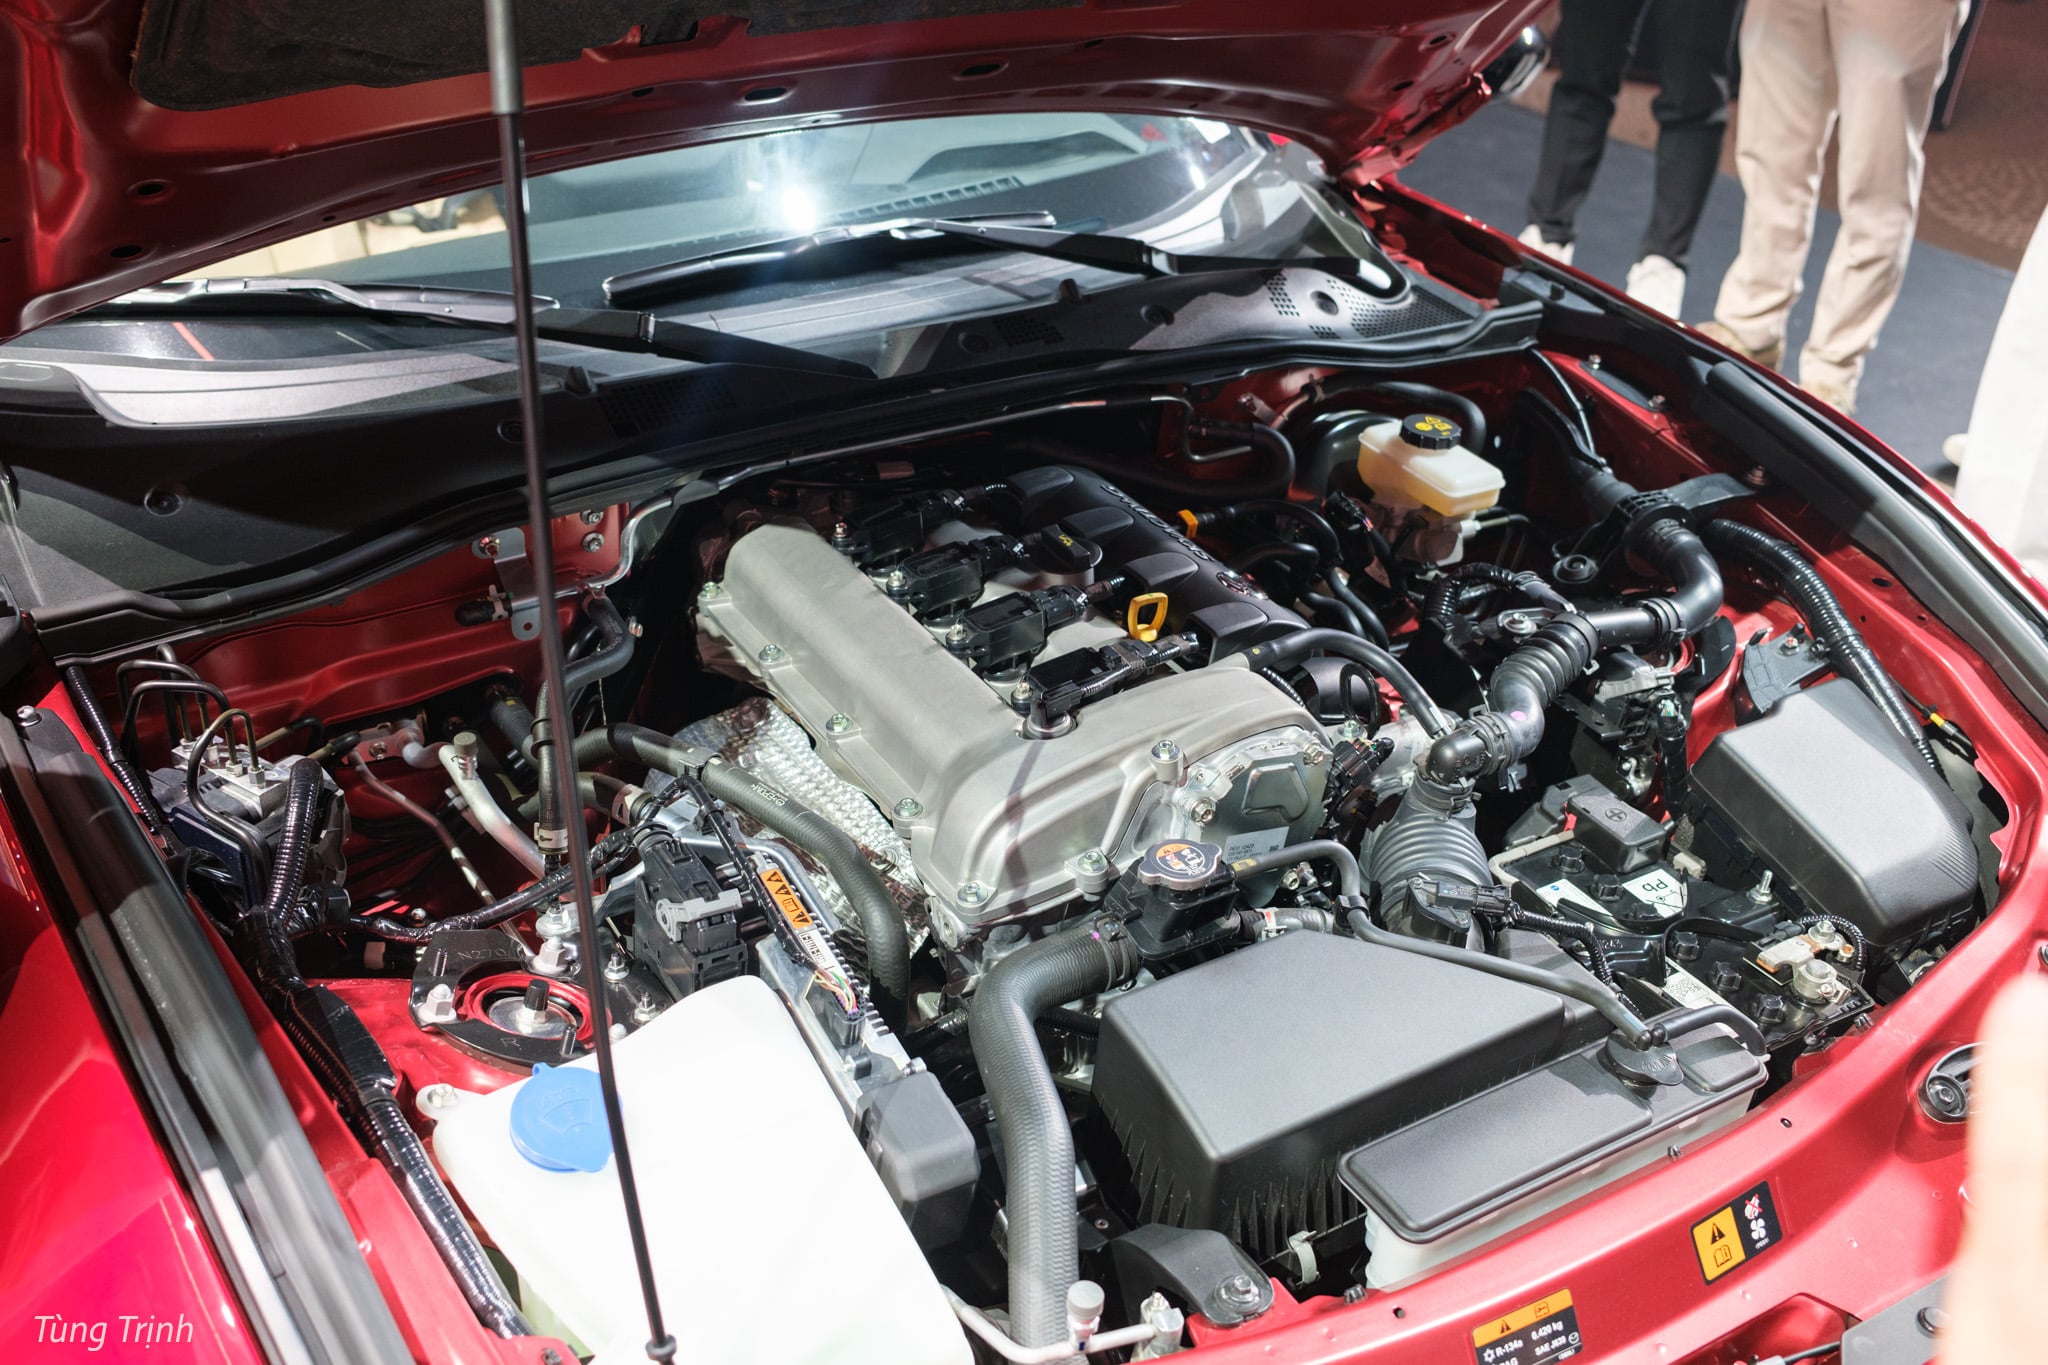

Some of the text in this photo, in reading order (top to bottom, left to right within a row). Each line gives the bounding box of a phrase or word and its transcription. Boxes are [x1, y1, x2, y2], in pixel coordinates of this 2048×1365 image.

[1495, 1339, 1523, 1357] R-134a
[1552, 1321, 1564, 1332] kg
[1534, 1343, 1551, 1356] SAE
